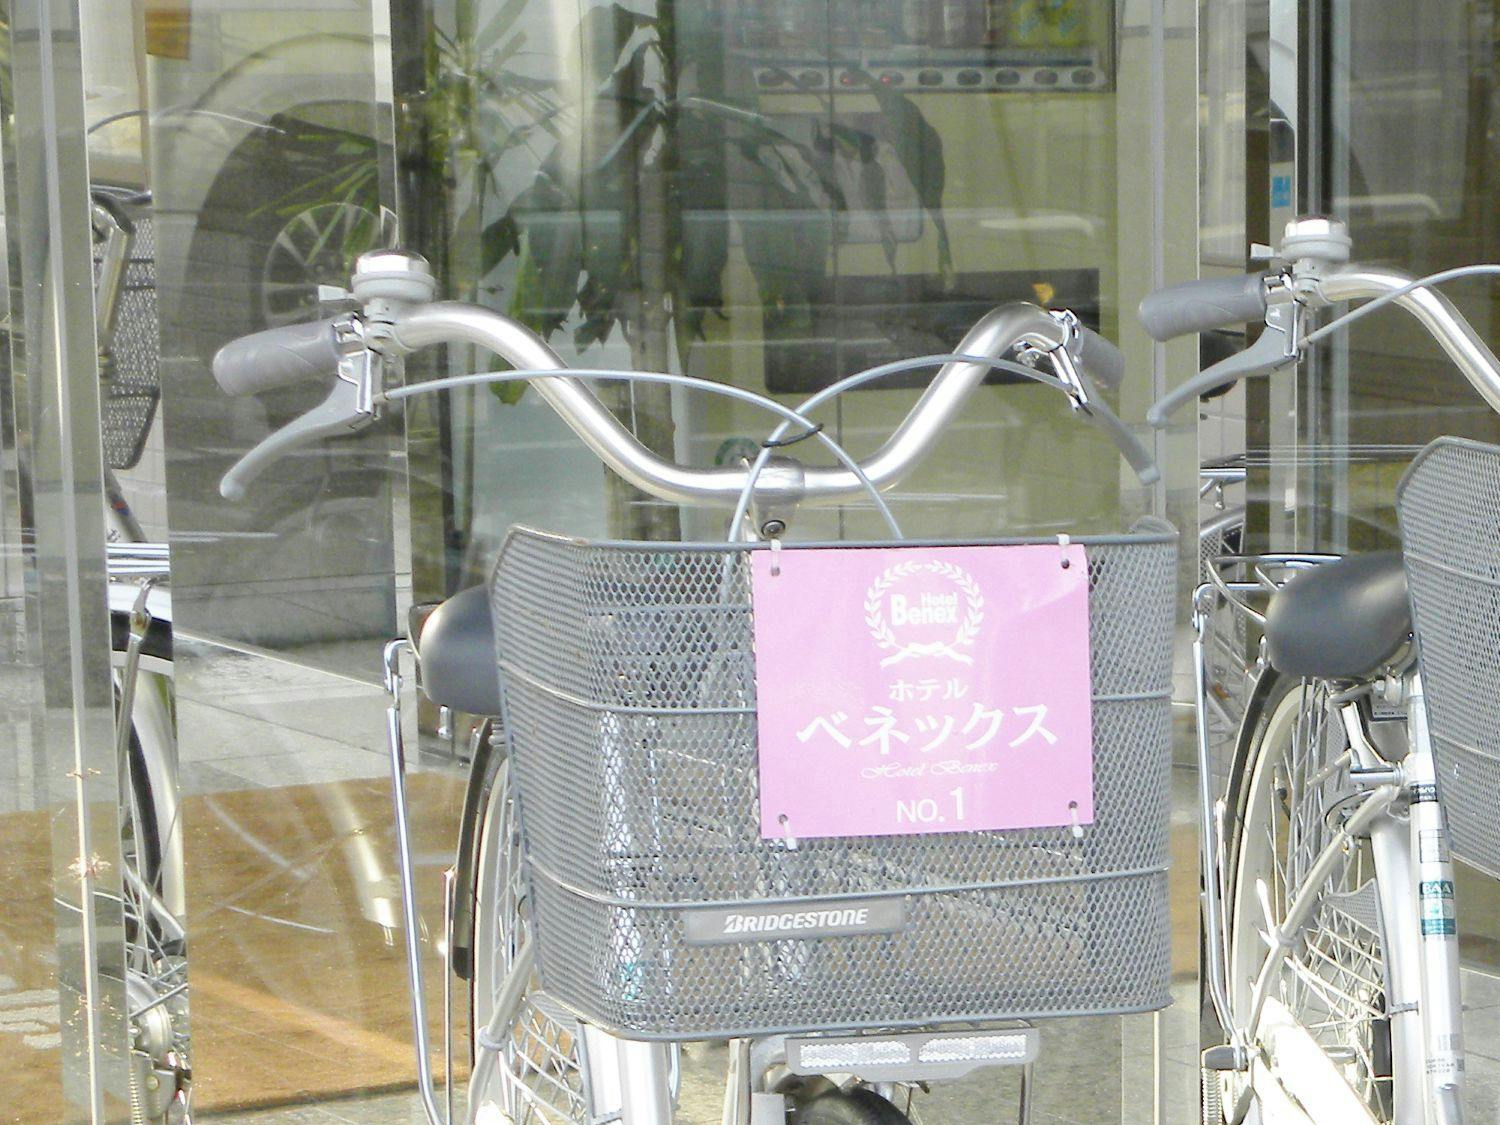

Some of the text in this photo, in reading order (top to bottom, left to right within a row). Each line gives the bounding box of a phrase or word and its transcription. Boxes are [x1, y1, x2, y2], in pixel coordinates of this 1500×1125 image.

[891, 593, 958, 626] Benex
[920, 592, 958, 607] Hotel
[888, 678, 969, 702] ホテル
[796, 702, 1059, 755] ベネックス
[860, 759, 999, 780] Hotel Benex
[895, 785, 965, 823] NO.1
[1421, 882, 1452, 895] BAA
[722, 908, 870, 934] BRIDGESTONE
